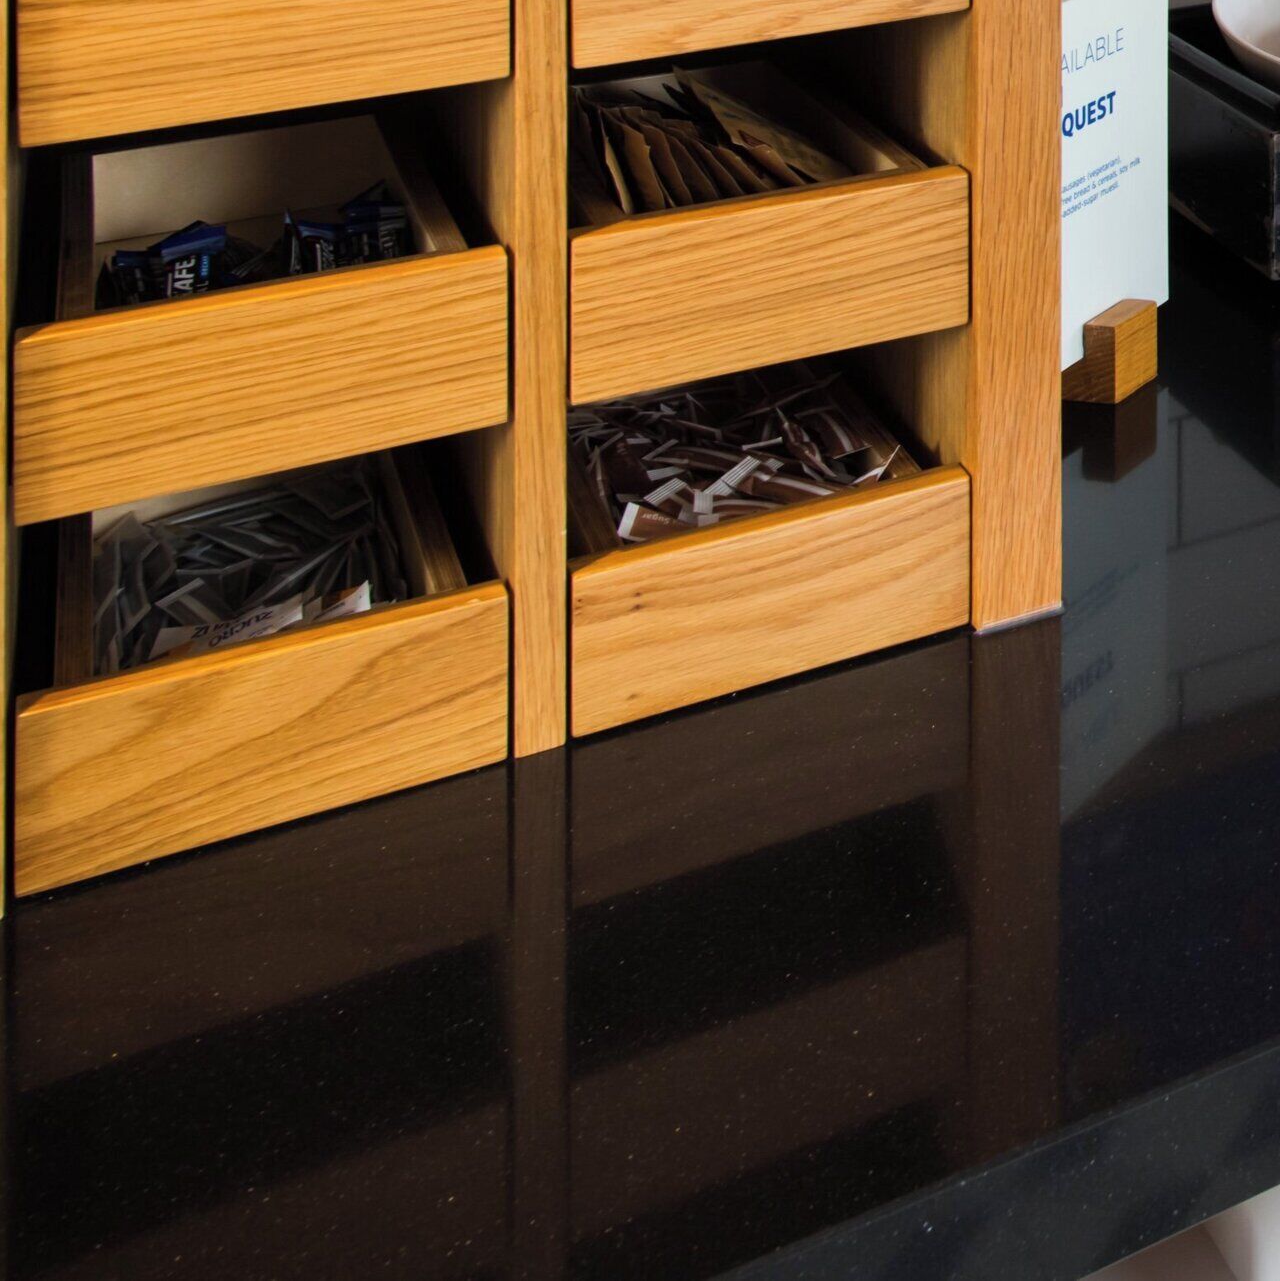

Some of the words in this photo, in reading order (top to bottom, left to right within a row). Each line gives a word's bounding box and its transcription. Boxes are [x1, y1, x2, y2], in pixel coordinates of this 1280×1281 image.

[1062, 27, 1124, 74] AILABLE
[1062, 90, 1117, 137] QUEST
[1062, 175, 1086, 194] ausages
